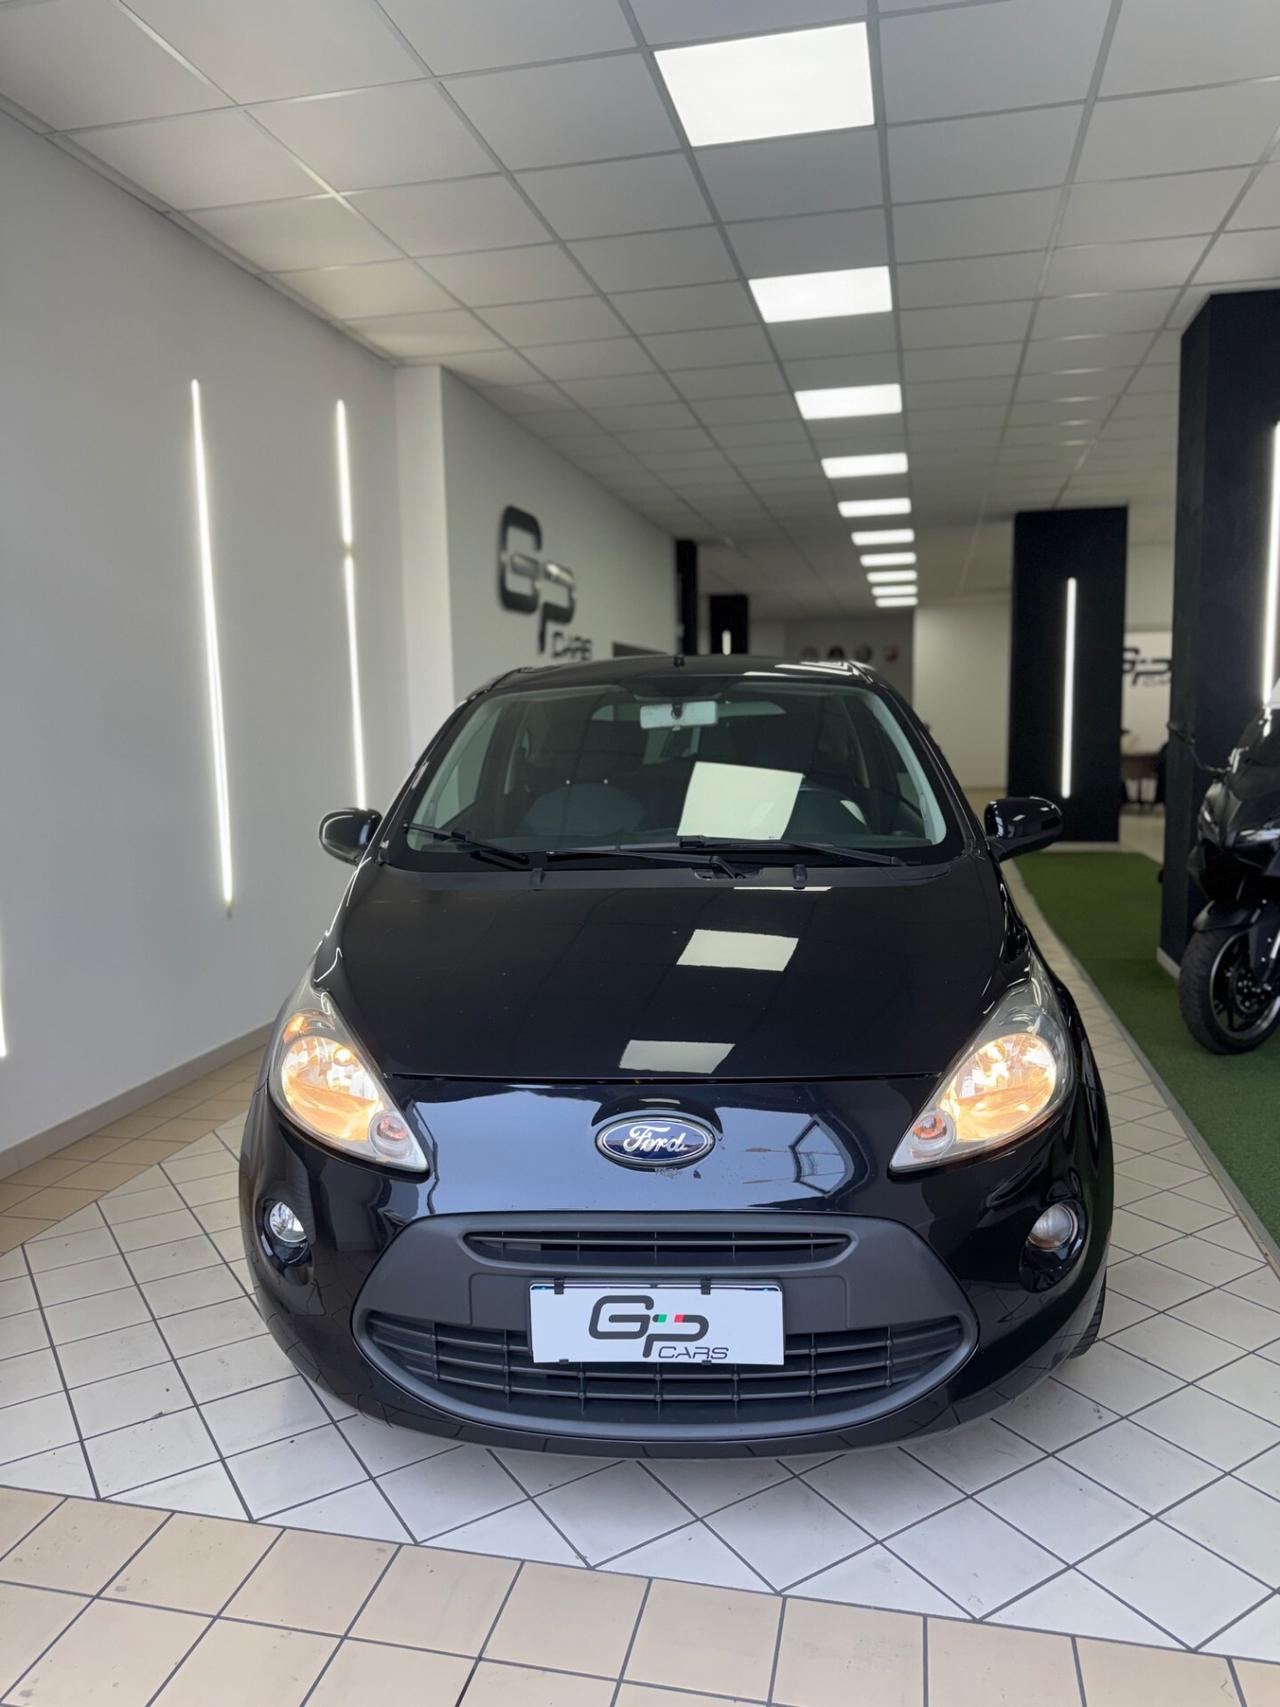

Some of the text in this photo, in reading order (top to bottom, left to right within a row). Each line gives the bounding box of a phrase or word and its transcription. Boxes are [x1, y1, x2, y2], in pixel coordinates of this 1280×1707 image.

[623, 1125, 689, 1152] Ford
[588, 1295, 709, 1358] GP
[658, 1346, 729, 1360] CARS
